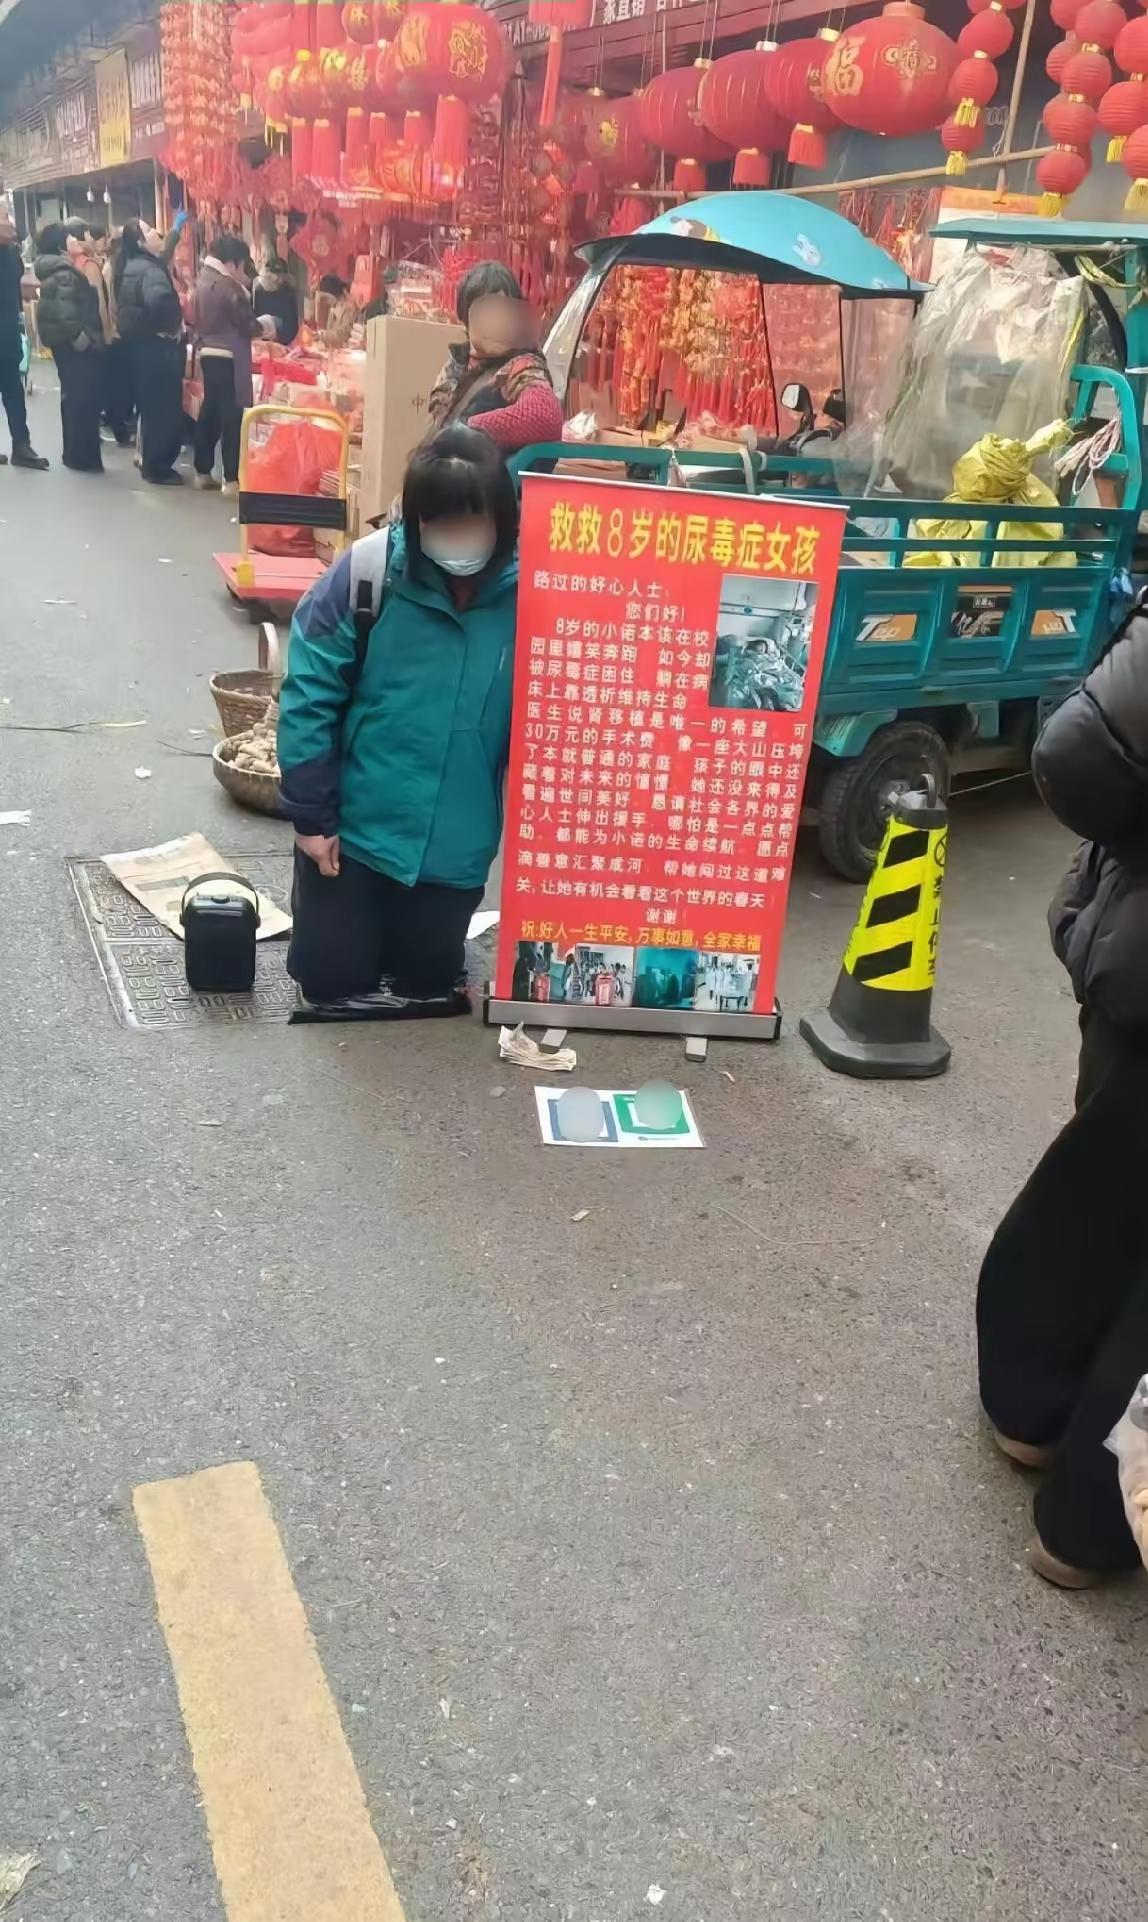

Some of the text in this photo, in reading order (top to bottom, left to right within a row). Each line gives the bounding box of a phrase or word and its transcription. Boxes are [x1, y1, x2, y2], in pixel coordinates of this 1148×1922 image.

[550, 501, 821, 575] 救救8岁的尿毒症女孩
[556, 617, 711, 648] 8岁的小诺本该在校
